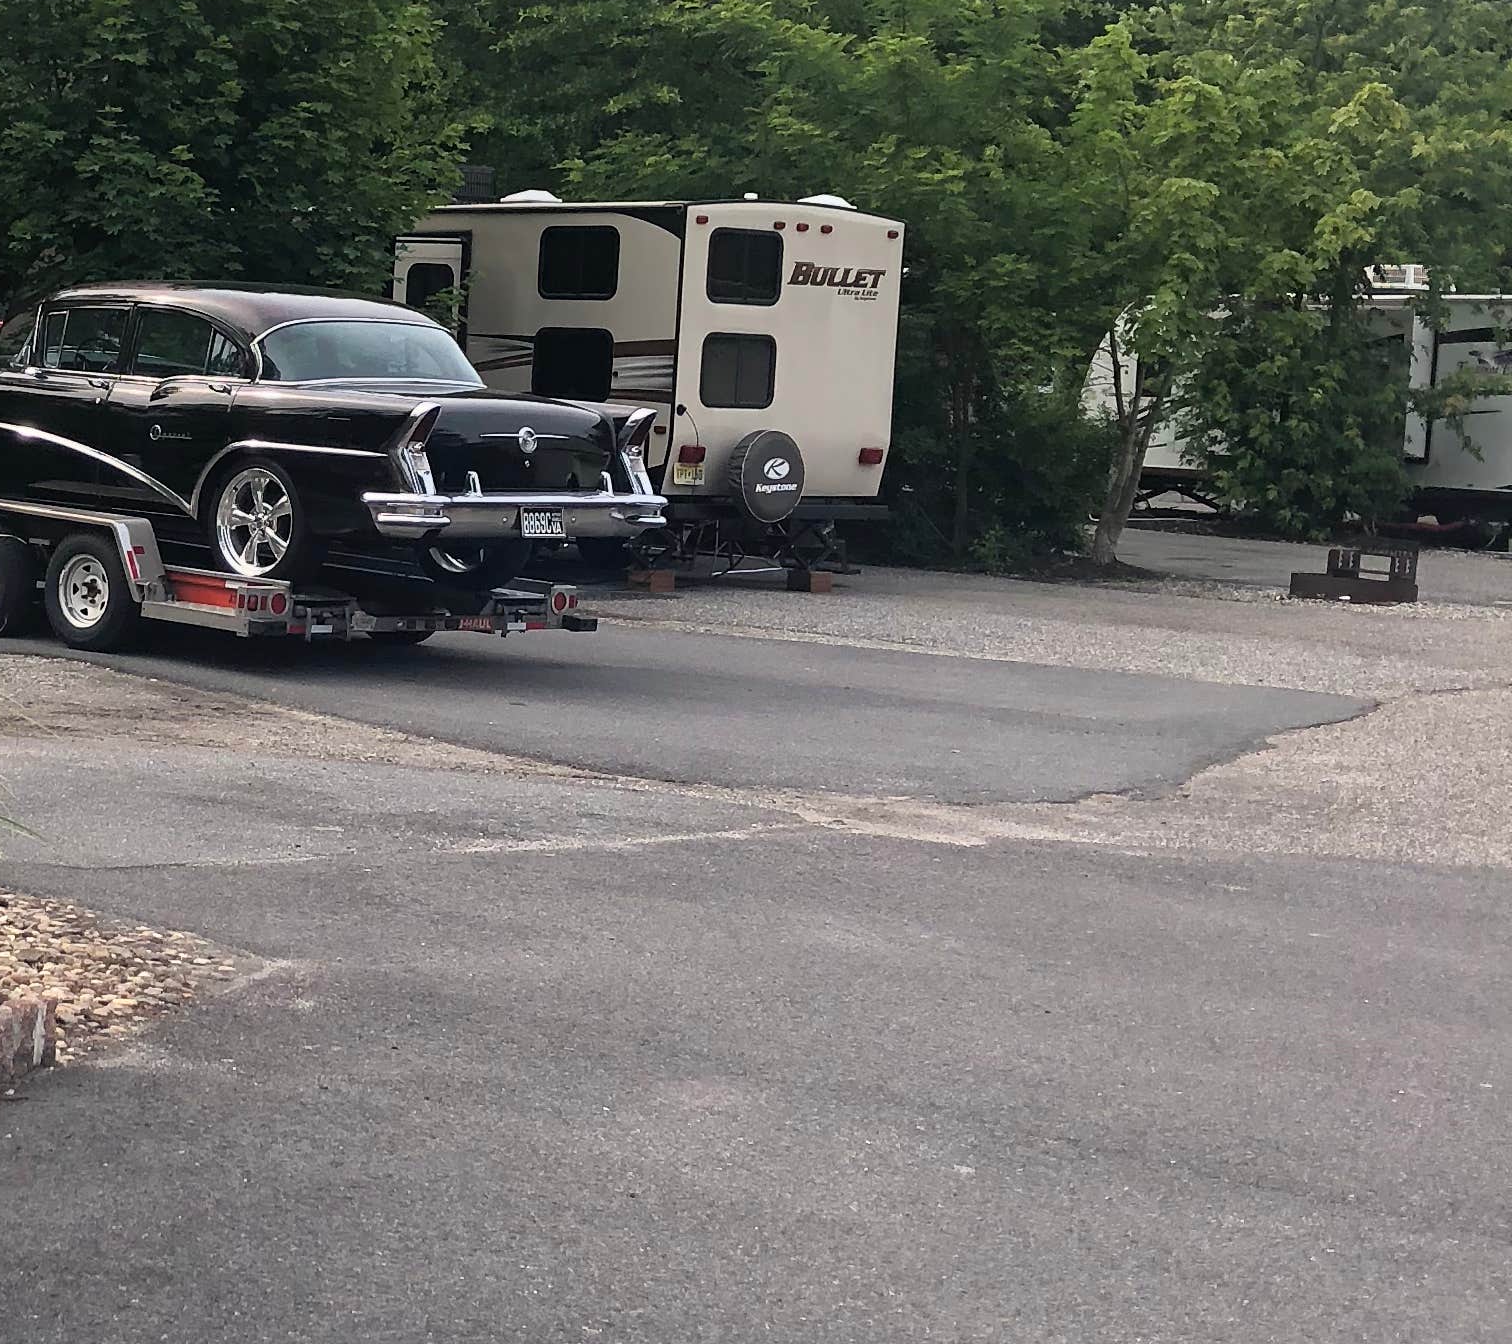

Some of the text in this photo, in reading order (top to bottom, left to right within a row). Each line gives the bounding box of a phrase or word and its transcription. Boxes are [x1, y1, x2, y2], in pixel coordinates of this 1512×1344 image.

[786, 261, 887, 289] BULLET
[837, 288, 879, 297] Ultra Lite
[755, 483, 798, 494] Keystone
